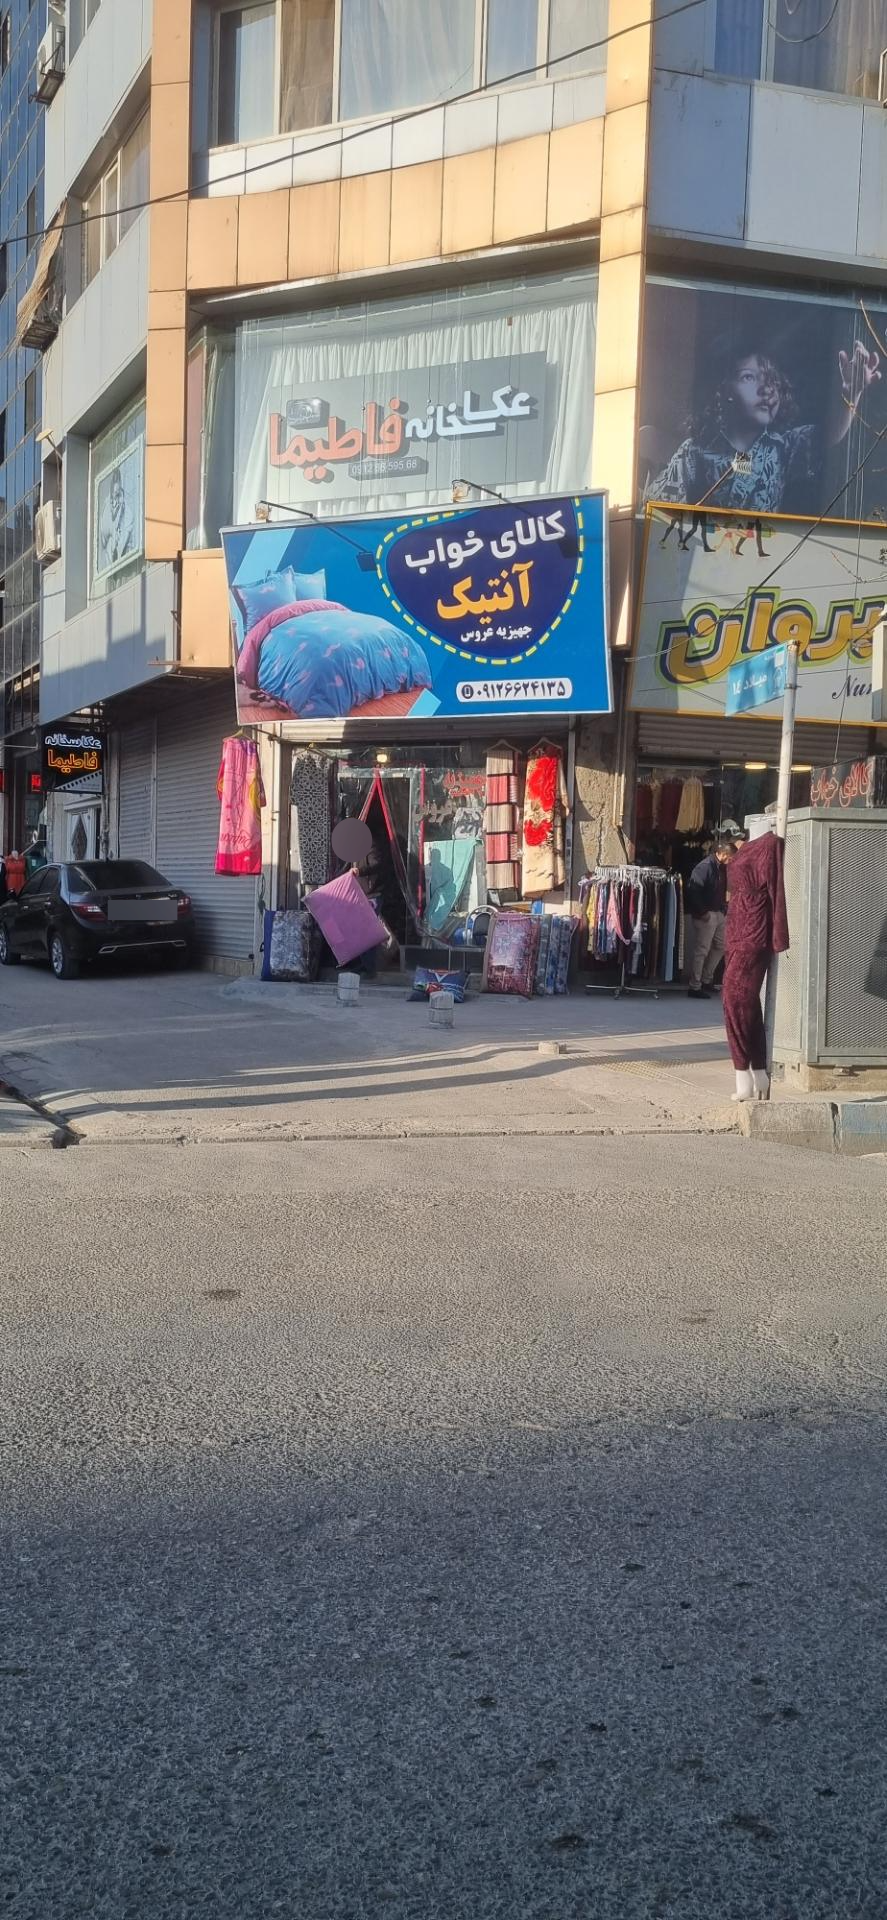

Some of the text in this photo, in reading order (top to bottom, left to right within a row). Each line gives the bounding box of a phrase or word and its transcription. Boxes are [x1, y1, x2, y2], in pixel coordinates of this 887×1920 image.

[270, 385, 530, 480] عکاسخانه فاطیما
[404, 510, 566, 574] کالای خواب
[437, 561, 534, 624] آنتیک
[460, 625, 532, 642] جهیزیه عروس
[477, 681, 566, 698] ۰۹۱۲۶۶۲۴۱۳۵
[45, 733, 102, 749] عکاسخانه
[48, 749, 98, 773] فاطیما
[811, 762, 872, 808] کالای خواب
